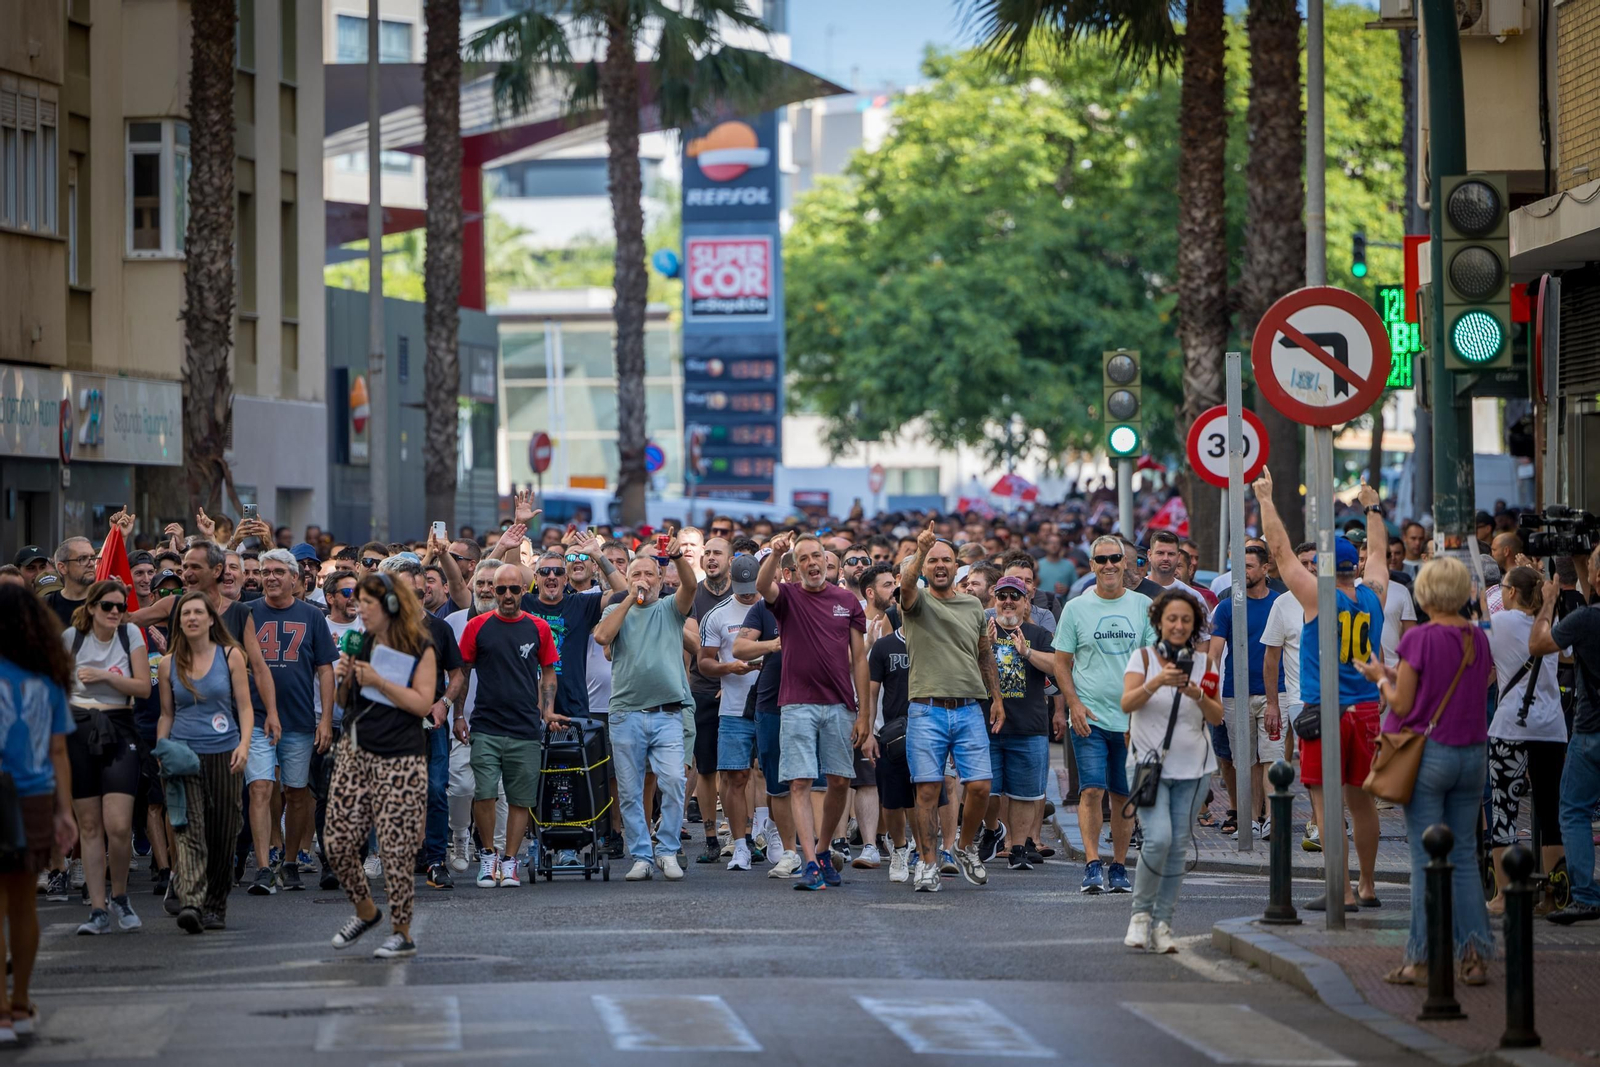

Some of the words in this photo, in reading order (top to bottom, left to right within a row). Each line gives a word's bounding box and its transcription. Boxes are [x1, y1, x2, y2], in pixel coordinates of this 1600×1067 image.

[686, 186, 771, 206] REPSOL
[693, 245, 765, 267] SUPER
[693, 267, 765, 296] COR
[256, 621, 307, 662] 47
[1093, 630, 1136, 640] Quiksilver
[1338, 610, 1372, 664] 10
[889, 653, 911, 672] PU
